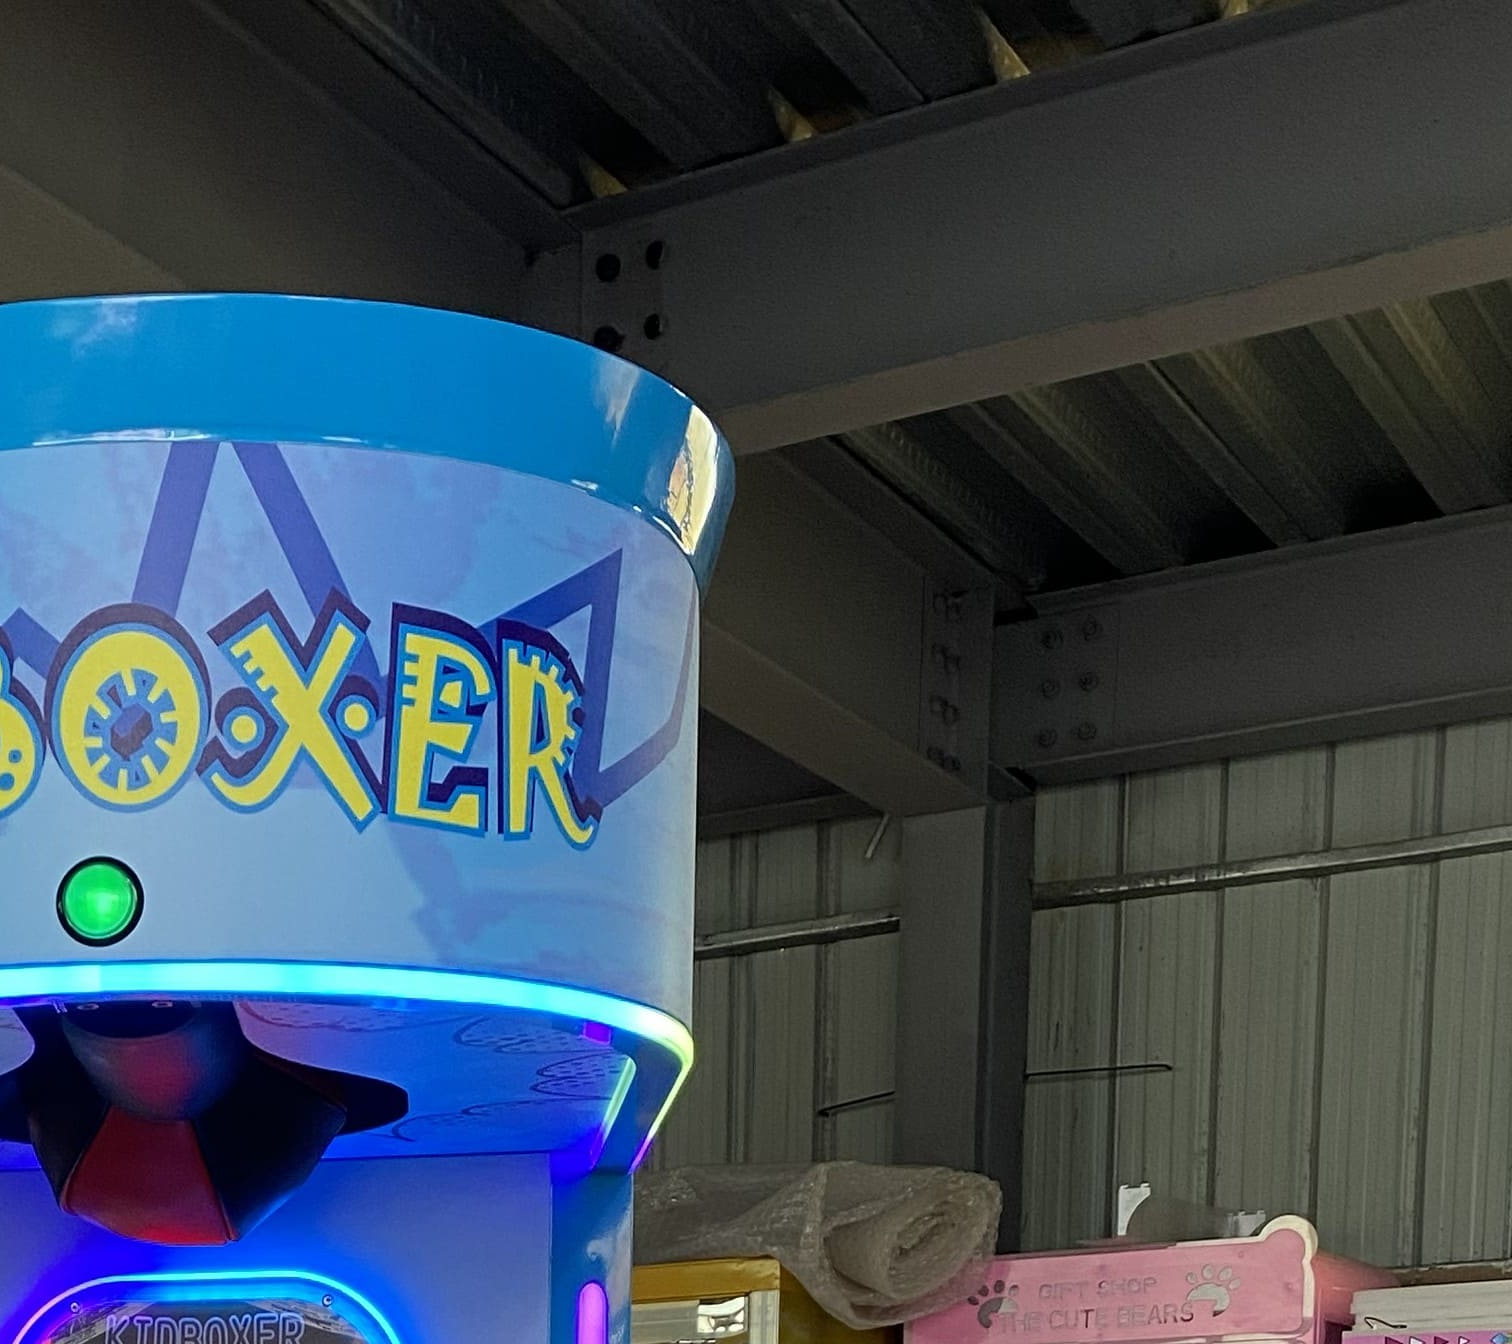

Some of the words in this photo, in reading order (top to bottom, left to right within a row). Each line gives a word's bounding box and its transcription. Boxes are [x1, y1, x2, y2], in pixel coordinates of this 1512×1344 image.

[1039, 1281, 1088, 1299] GIFT
[1097, 1277, 1157, 1297] SHOP
[999, 1310, 1041, 1333] THE
[1049, 1307, 1110, 1331] CUTE
[1117, 1302, 1194, 1328] BEARS
